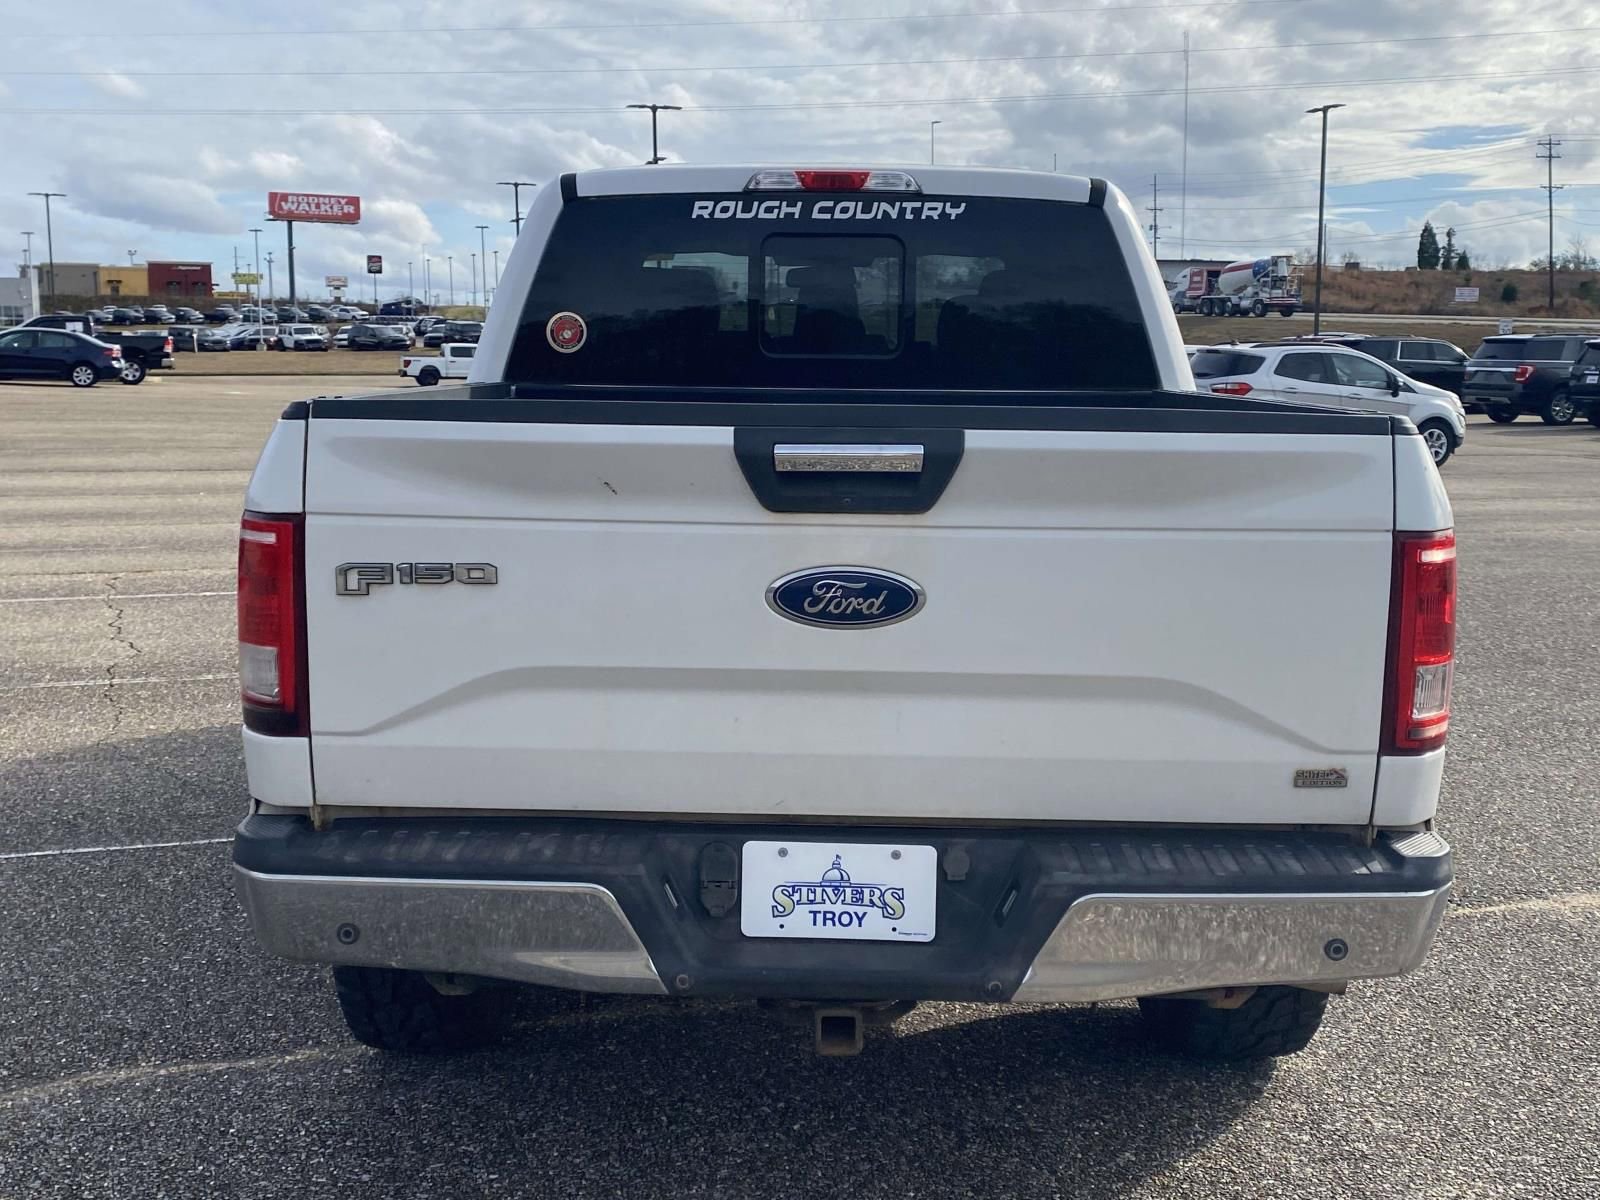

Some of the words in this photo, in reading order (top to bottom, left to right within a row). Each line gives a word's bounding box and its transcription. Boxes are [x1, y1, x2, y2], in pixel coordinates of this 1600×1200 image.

[280, 201, 356, 214] WALKER
[287, 195, 348, 205] RODNEY
[691, 201, 802, 219] ROUGH
[811, 201, 966, 220] COUNTRY
[803, 579, 889, 615] Ford
[772, 884, 906, 920] STIVERS
[808, 910, 868, 927] TROY
